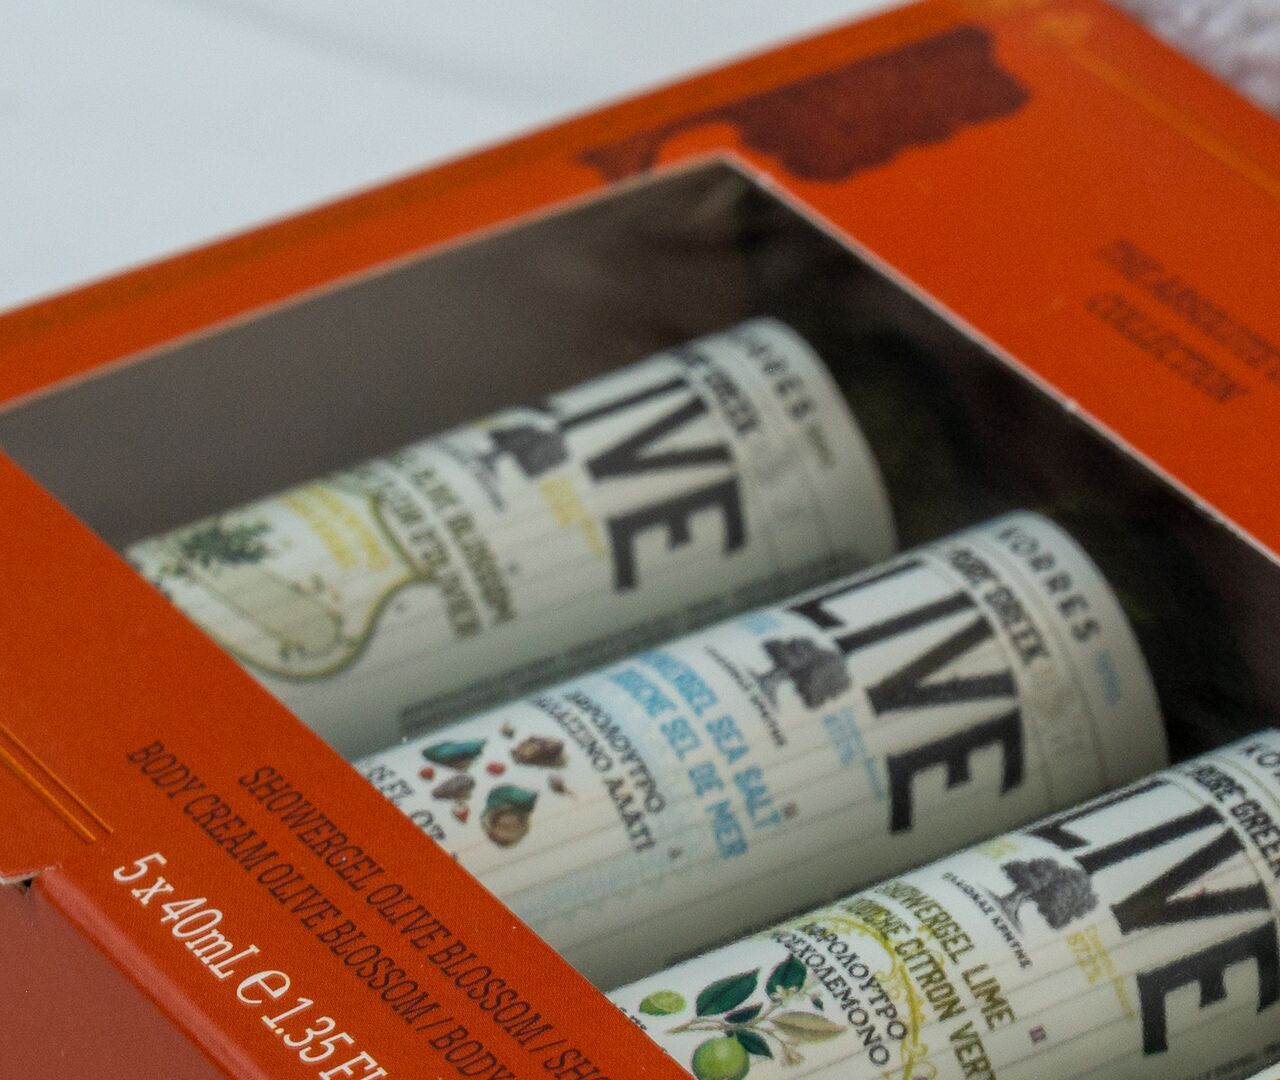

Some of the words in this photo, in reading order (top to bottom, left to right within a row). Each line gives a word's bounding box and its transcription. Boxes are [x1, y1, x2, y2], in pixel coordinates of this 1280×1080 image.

[786, 557, 1026, 835] LIVE
[705, 713, 750, 765] SEA
[733, 766, 782, 829] SALT
[113, 852, 167, 882] 5
[705, 800, 749, 860] MER
[126, 740, 205, 799] BODY
[183, 788, 271, 873] CREAM
[256, 863, 341, 931] OLIVE
[316, 919, 442, 1026] BLOSSOM
[131, 876, 174, 907] x
[238, 765, 385, 893] SHOWERGEL
[365, 883, 451, 952] OLIVE
[428, 939, 555, 1047] BLOSSOM
[160, 897, 260, 980] 40mL
[894, 937, 968, 1024] CITRON
[961, 963, 1017, 1033] LIME
[260, 997, 356, 1064] 1.35
